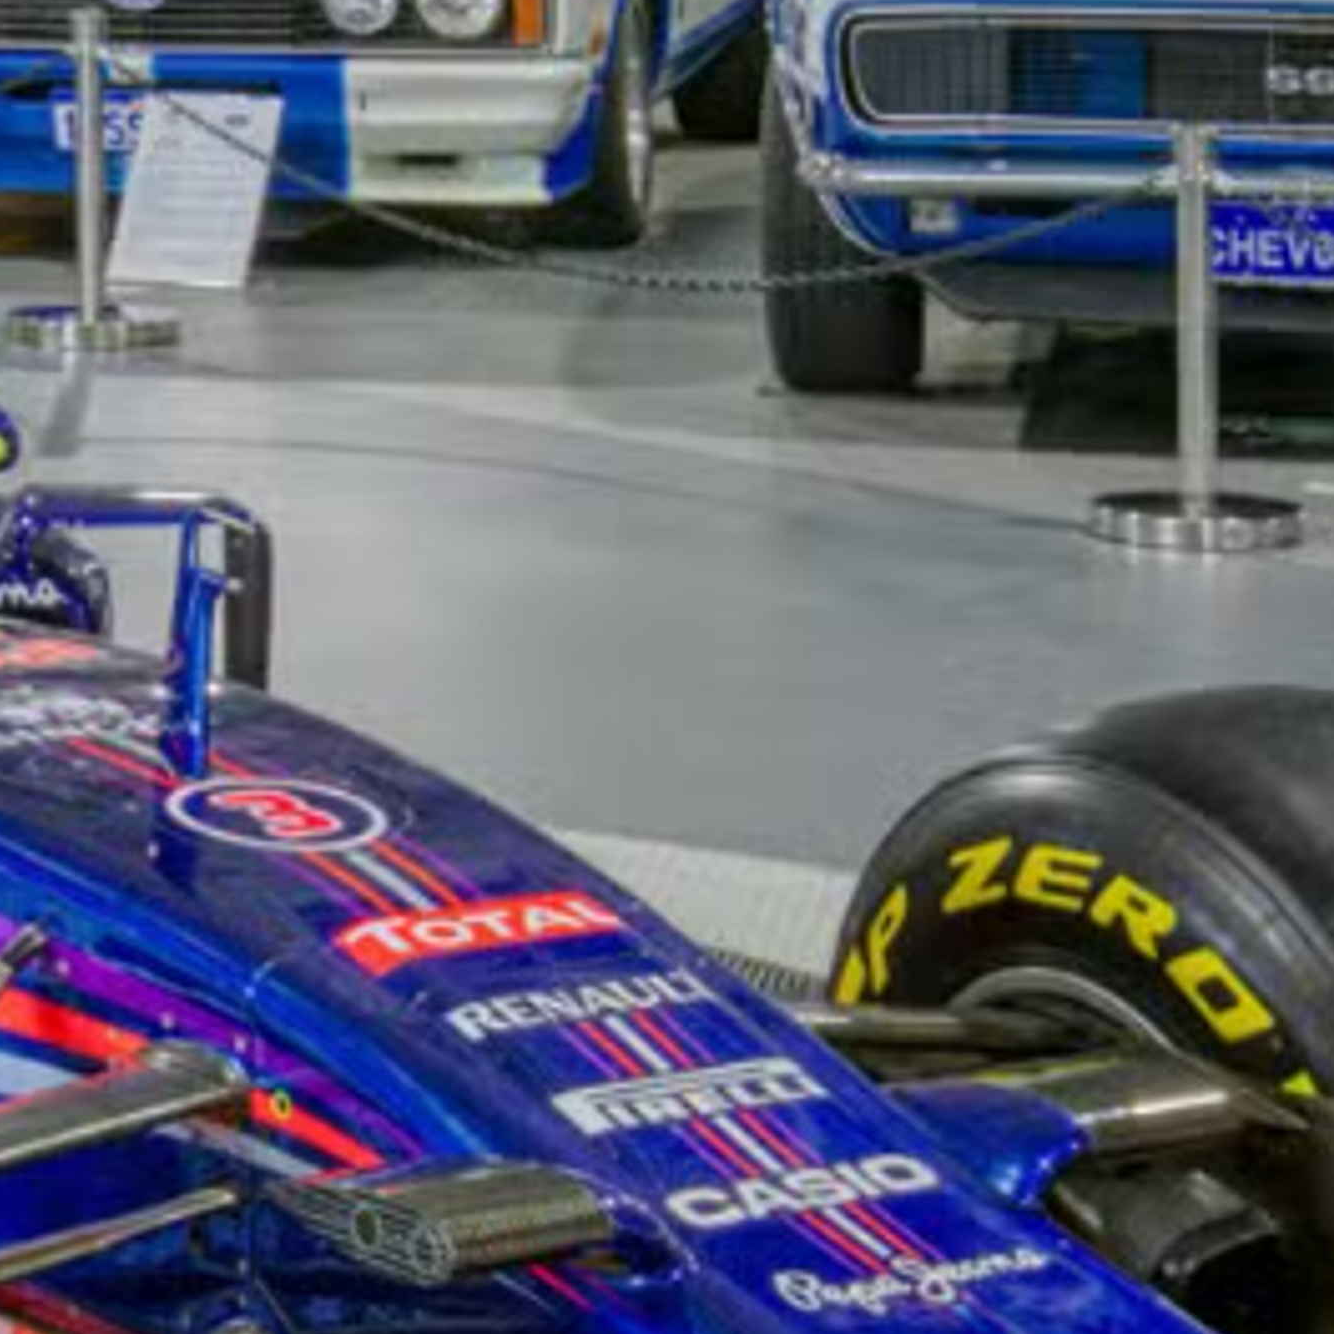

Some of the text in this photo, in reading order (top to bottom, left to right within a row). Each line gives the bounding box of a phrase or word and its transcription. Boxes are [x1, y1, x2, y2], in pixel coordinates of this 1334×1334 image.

[208, 788, 343, 838] 3
[342, 899, 621, 953] TOTAL
[869, 834, 1275, 1044] P ZERO
[551, 1057, 833, 1136] PIRELLI
[667, 1153, 939, 1229] CASIO
[889, 1247, 1050, 1304] Jeans
